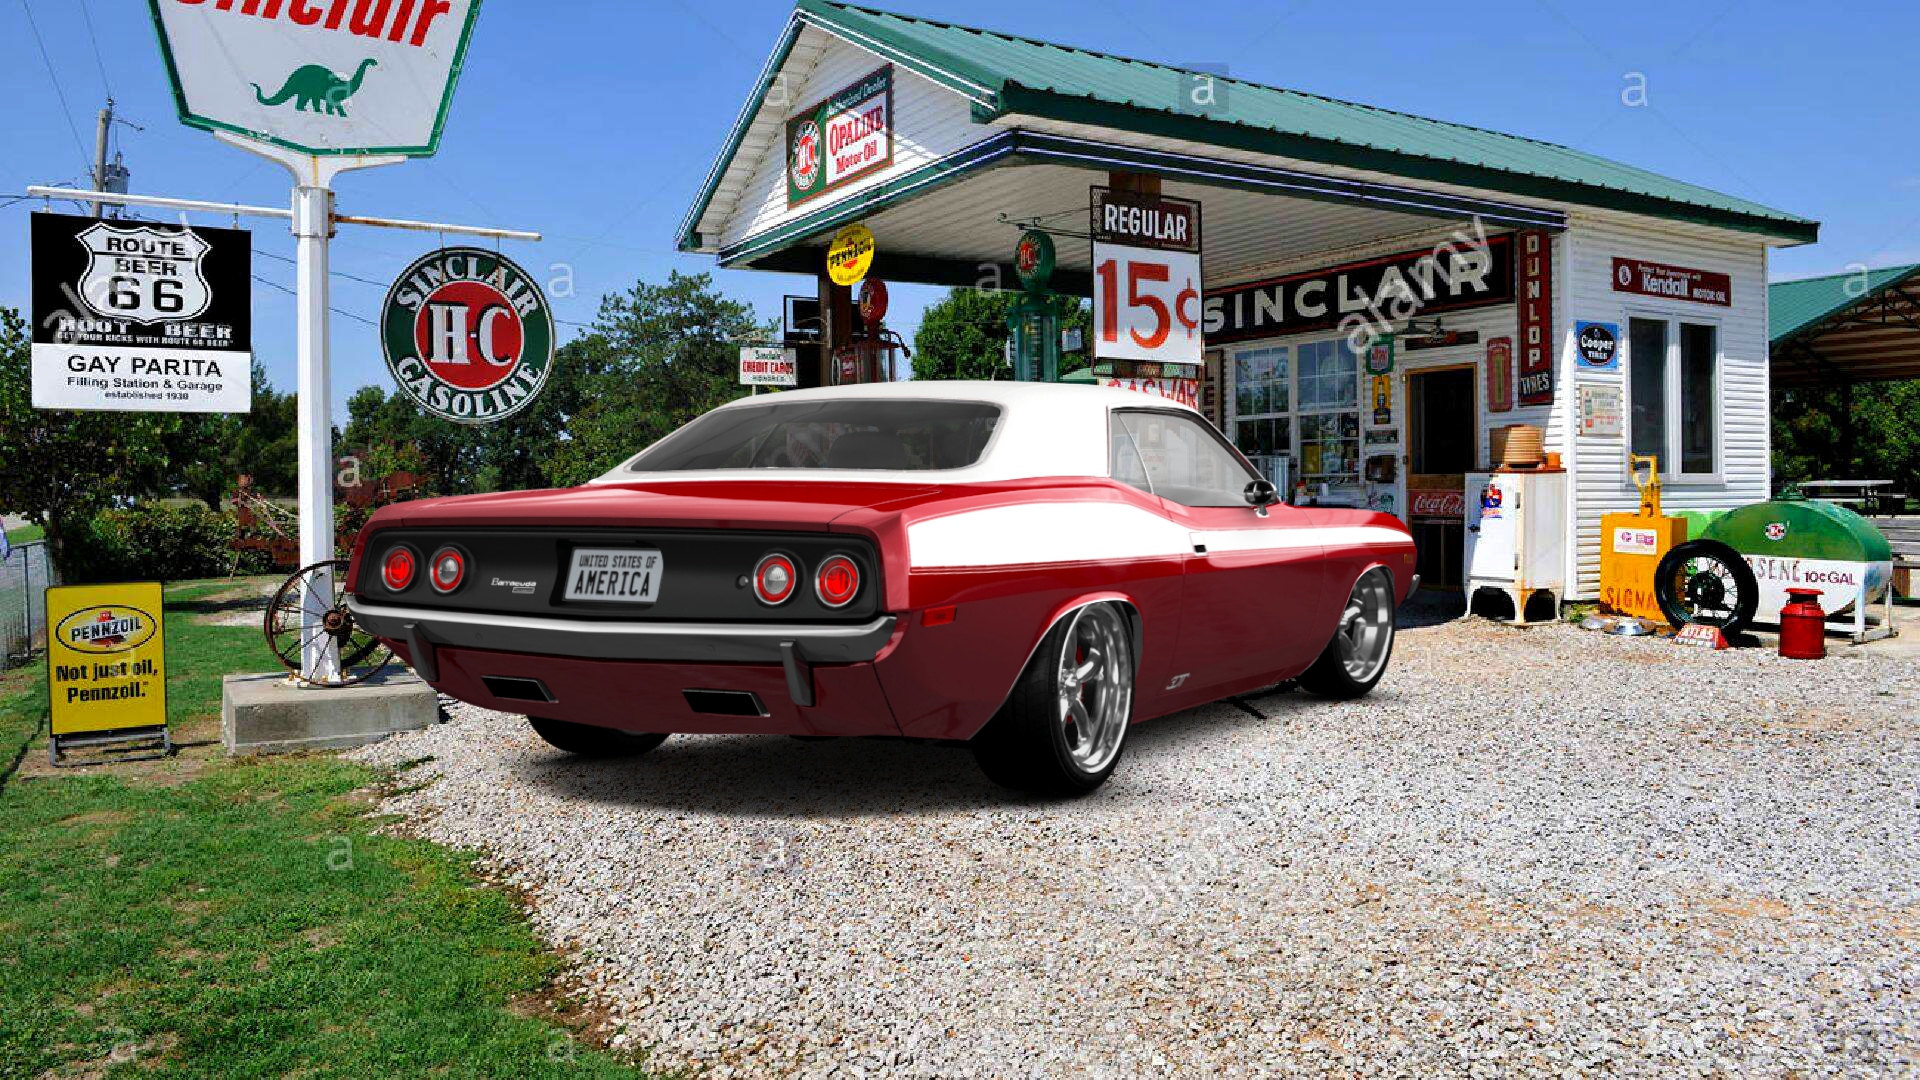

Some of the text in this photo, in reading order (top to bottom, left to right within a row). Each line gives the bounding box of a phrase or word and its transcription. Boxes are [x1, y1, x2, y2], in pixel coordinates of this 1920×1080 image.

[830, 105, 884, 156] OPALINE
[836, 139, 878, 174] Motor Oil
[1104, 203, 1187, 242] REGULAR
[107, 237, 186, 256] ROUTE
[115, 258, 178, 276] BEER
[108, 276, 184, 313] 66
[397, 256, 539, 318] SINCLAIR
[1203, 250, 1490, 333] SINCLAIR
[1642, 272, 1688, 296] Kendall
[1096, 259, 1199, 349] 15¢
[1526, 235, 1541, 368] DUNLOP
[164, 322, 233, 339] BEER
[1581, 334, 1614, 352] Cooper
[67, 355, 223, 377] GAY PARITA
[742, 360, 768, 374] CREDIT
[67, 376, 223, 393] Filling Station & Garage
[104, 390, 163, 400] established
[397, 356, 542, 416] GASOLINE
[1520, 372, 1550, 396] TIRES
[578, 554, 658, 569] UNITED STATES OF
[573, 570, 650, 597] AMERICA
[71, 617, 143, 642] PENNZOIL
[55, 659, 158, 682] Not just oil,
